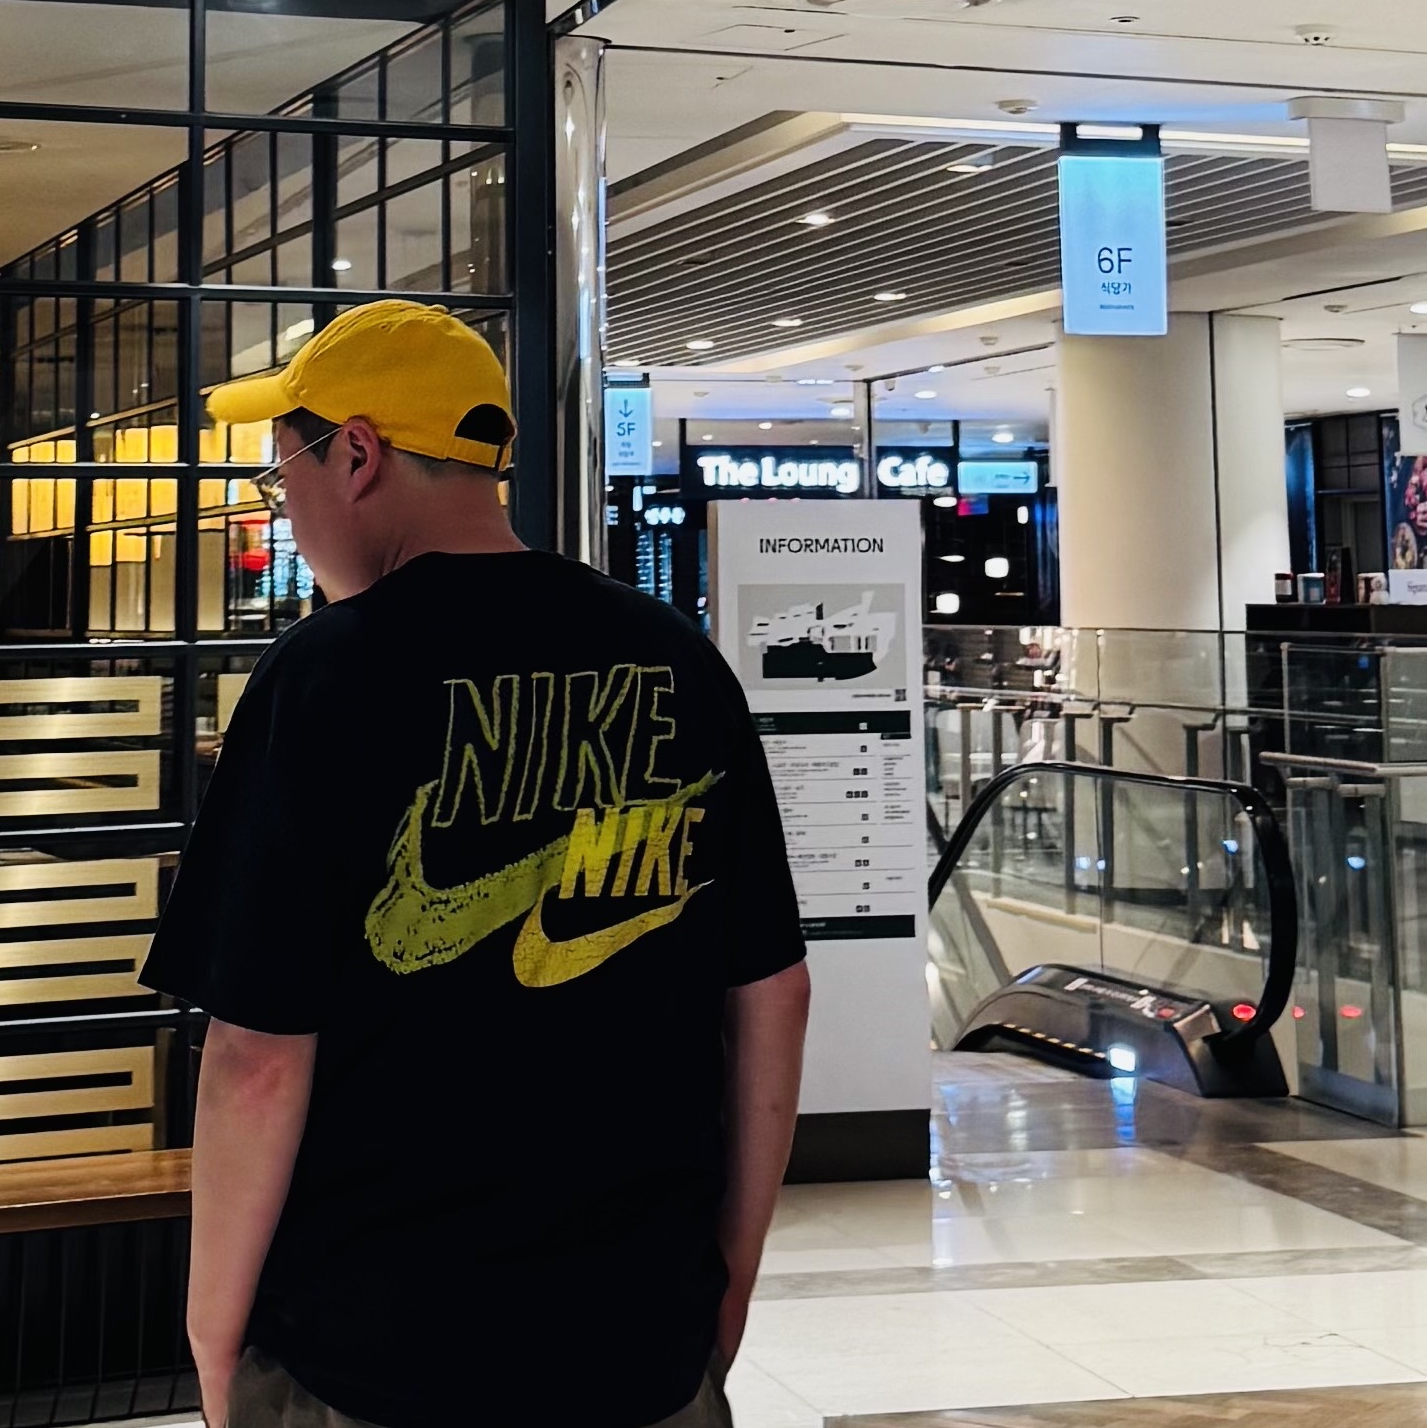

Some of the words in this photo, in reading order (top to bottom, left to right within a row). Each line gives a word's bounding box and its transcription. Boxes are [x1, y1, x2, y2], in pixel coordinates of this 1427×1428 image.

[1097, 247, 1133, 275] 6F
[1100, 281, 1132, 296] 식당가
[616, 422, 636, 437] 5F
[697, 455, 759, 487] The
[760, 456, 860, 494] Loung
[876, 453, 949, 488] Cafe
[759, 537, 884, 553] INFORMATION
[431, 664, 681, 827] NIKE
[559, 807, 705, 898] NIKE
